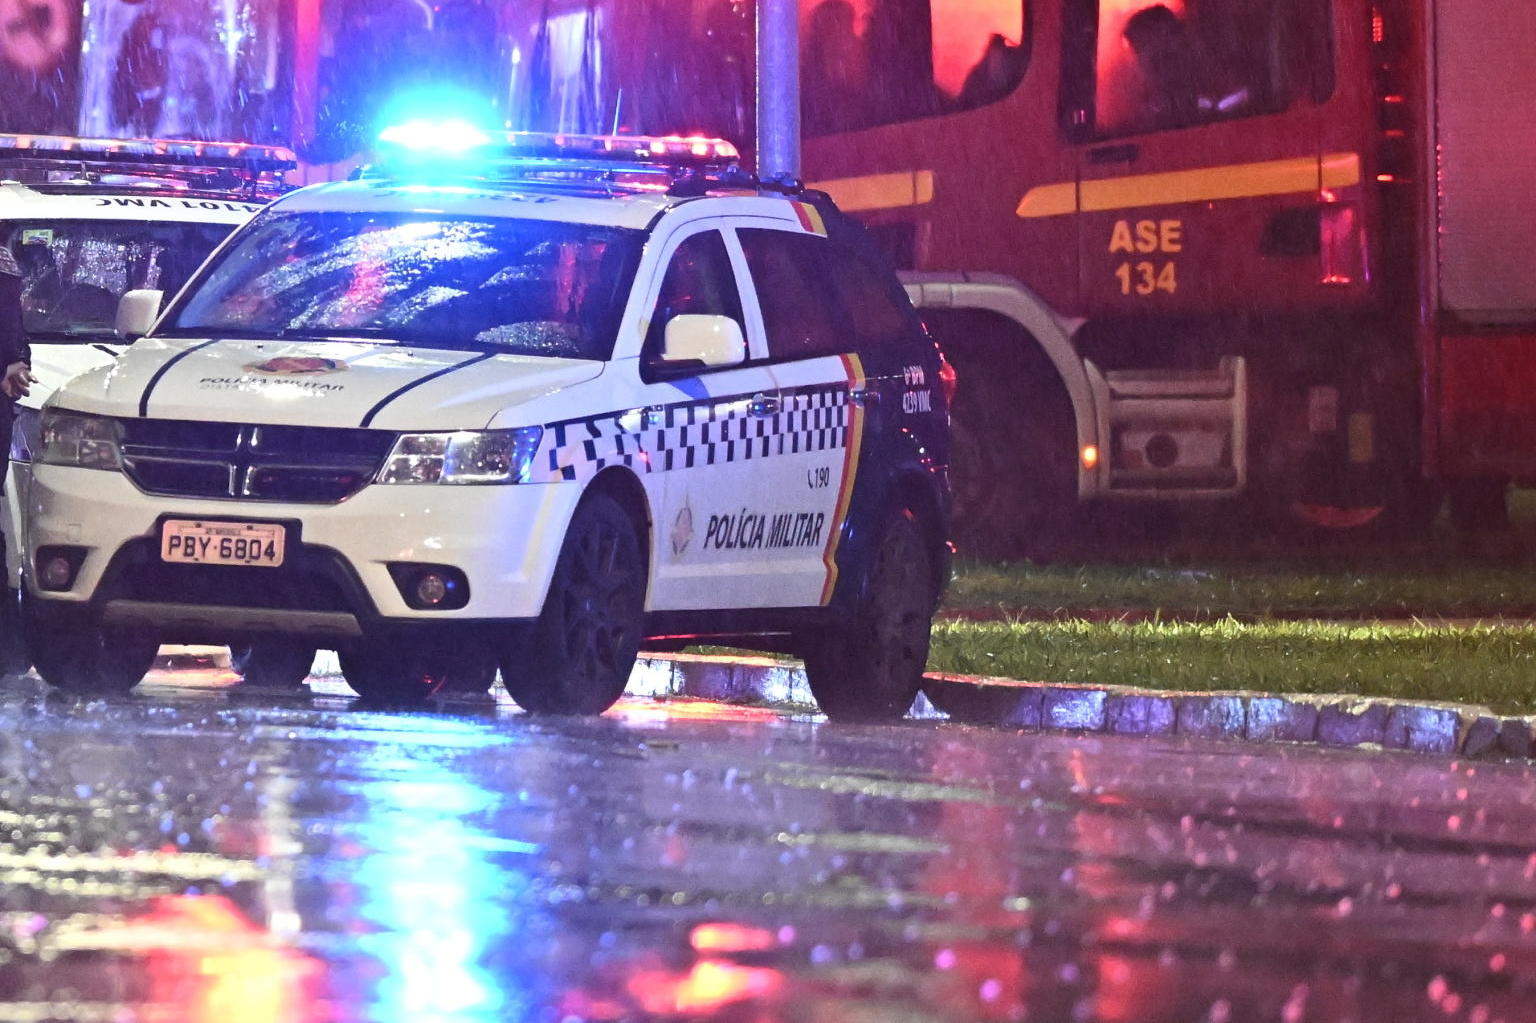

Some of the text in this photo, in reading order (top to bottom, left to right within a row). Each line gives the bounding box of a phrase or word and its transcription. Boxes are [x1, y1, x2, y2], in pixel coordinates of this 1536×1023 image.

[1108, 219, 1182, 253] ASE
[1115, 261, 1177, 295] 134
[814, 466, 830, 489] 190
[703, 507, 825, 550] POLÍCIA MILITAR
